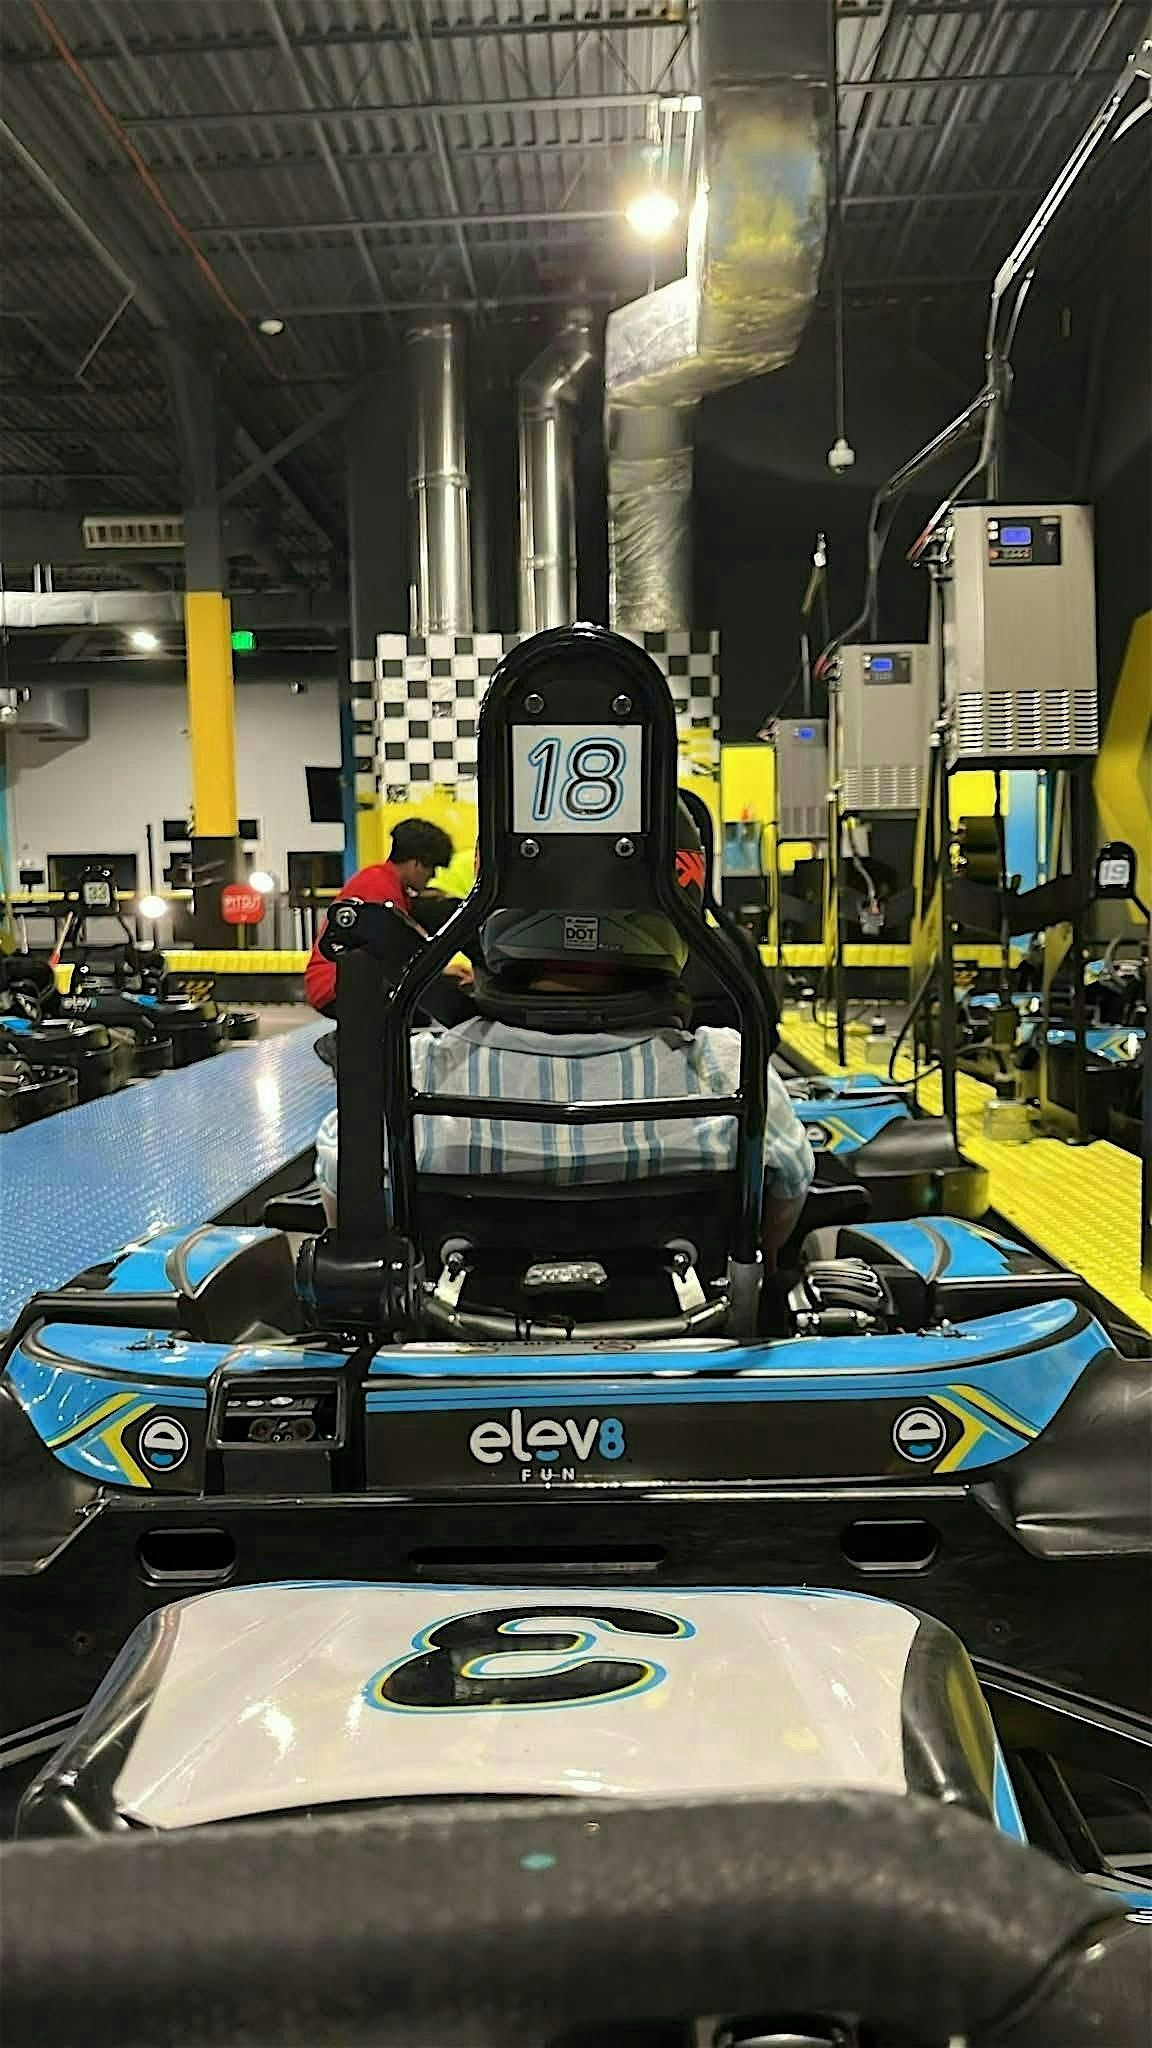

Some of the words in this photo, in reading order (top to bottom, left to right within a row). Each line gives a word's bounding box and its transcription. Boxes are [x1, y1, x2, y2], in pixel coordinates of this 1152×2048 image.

[528, 737, 626, 821] 18
[566, 928, 596, 940] DOT
[470, 1408, 625, 1464] elev8
[521, 1467, 575, 1482] FUN
